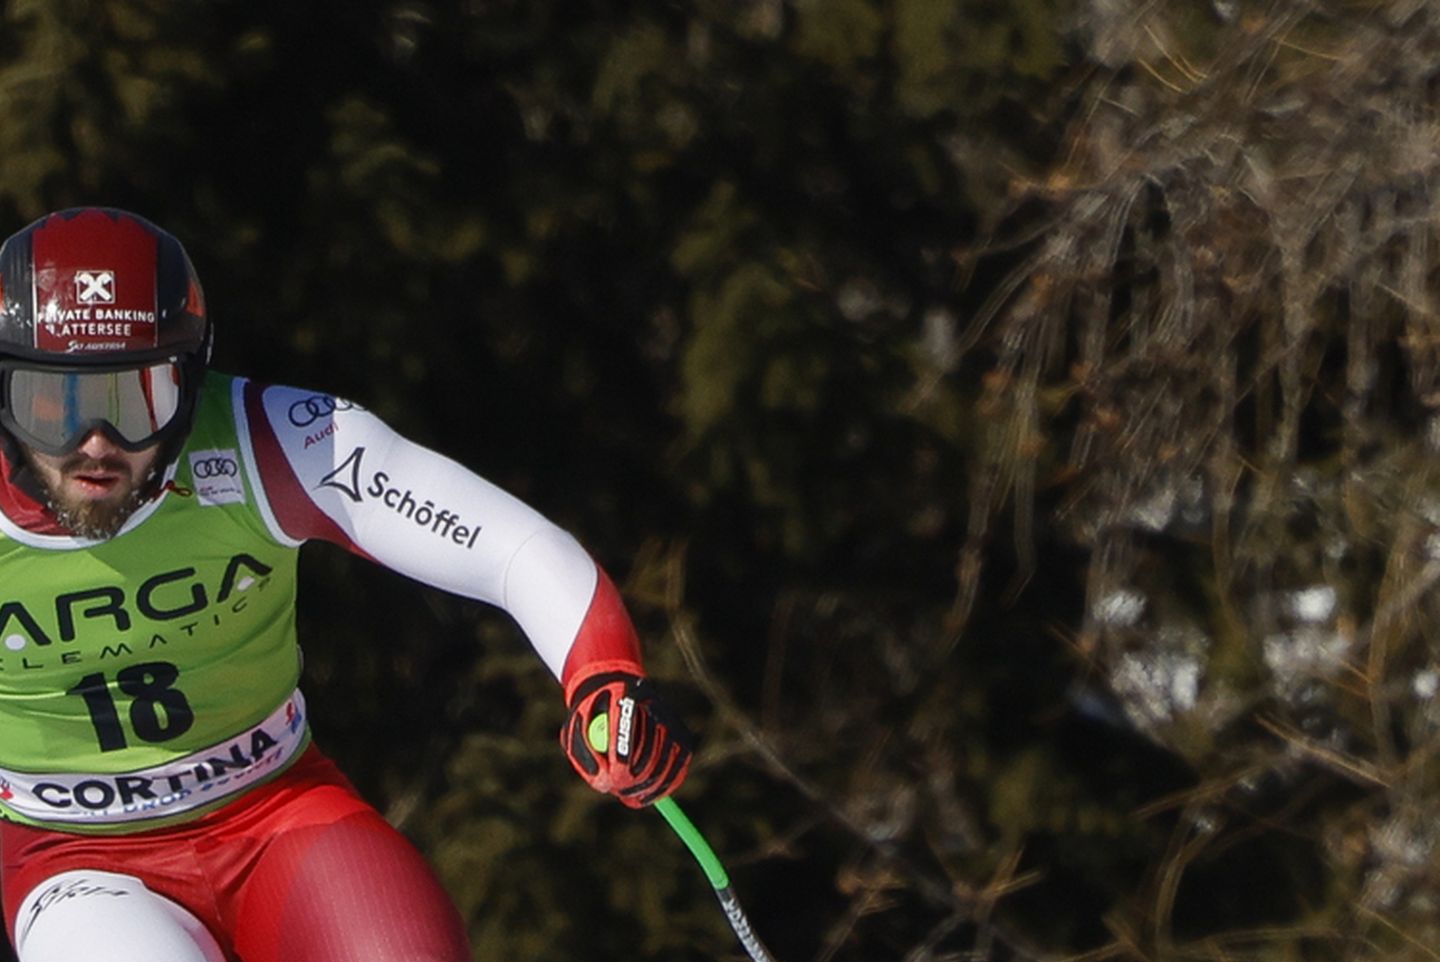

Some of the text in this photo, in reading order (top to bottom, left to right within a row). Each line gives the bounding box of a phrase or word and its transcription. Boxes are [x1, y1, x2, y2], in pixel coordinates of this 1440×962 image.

[95, 309, 155, 323] BANKING
[304, 421, 339, 450] Audi
[367, 470, 482, 549] Schöffel
[65, 660, 194, 753] 18
[31, 728, 278, 810] CORTINA
